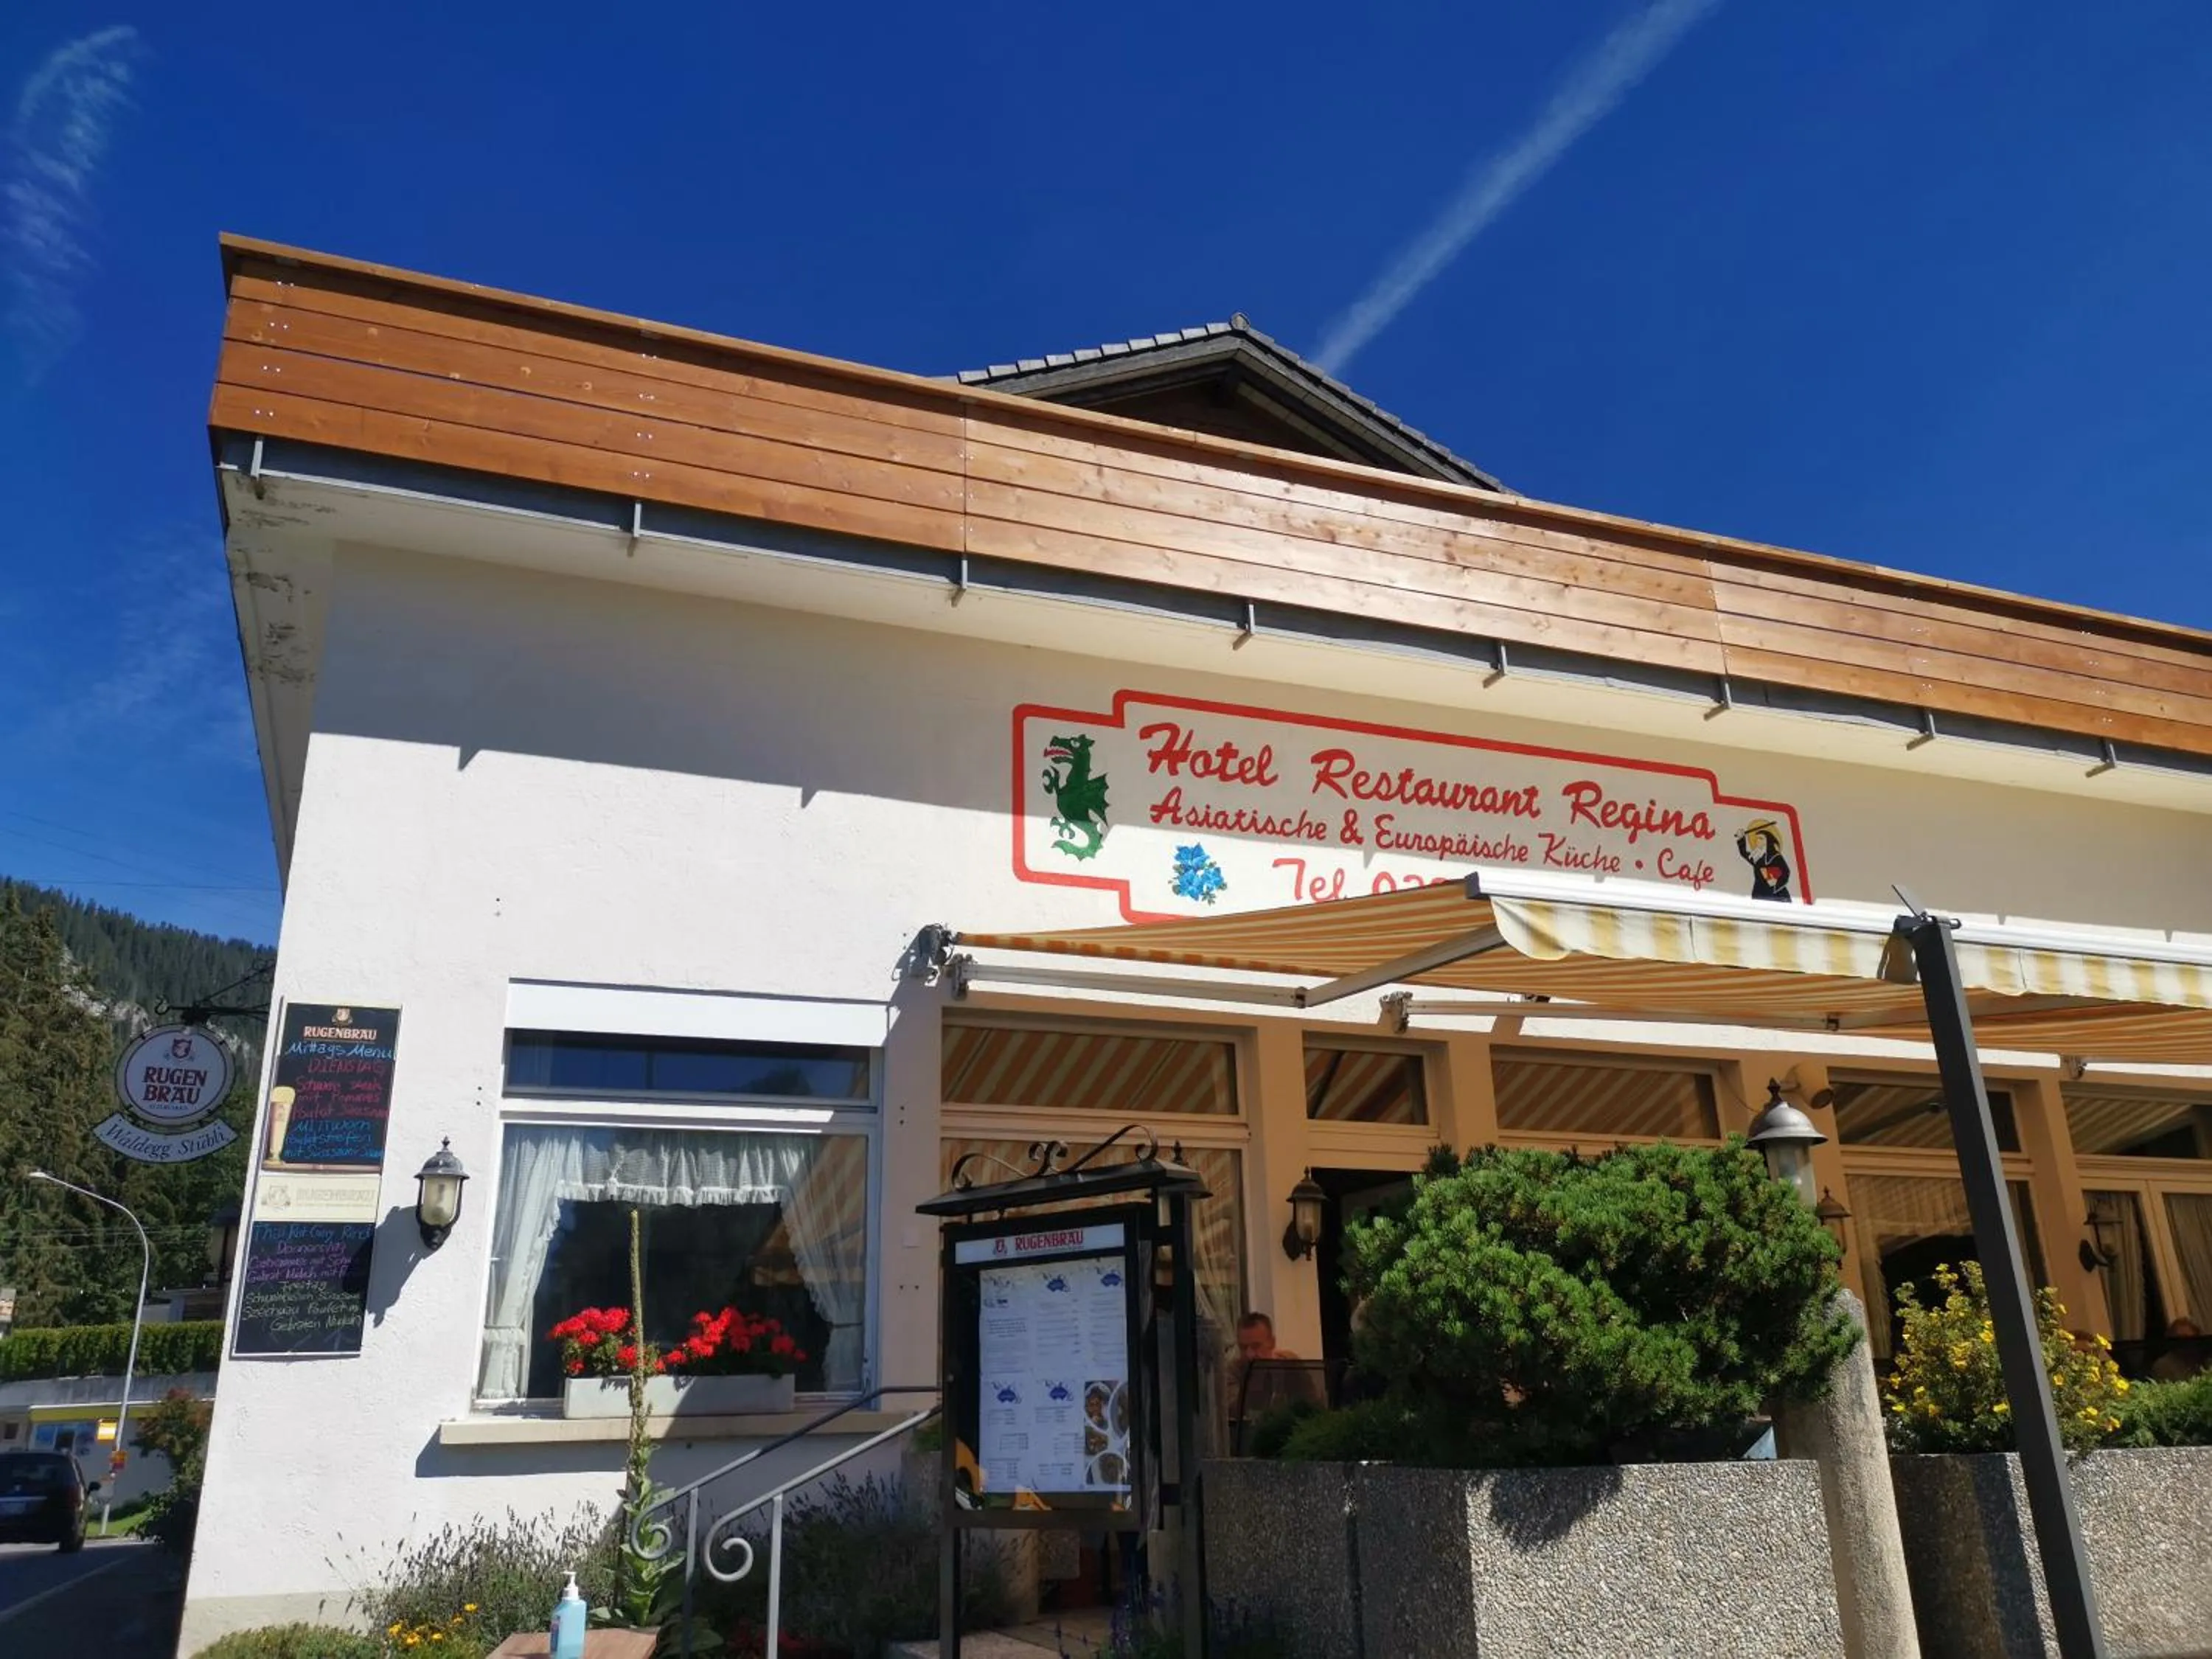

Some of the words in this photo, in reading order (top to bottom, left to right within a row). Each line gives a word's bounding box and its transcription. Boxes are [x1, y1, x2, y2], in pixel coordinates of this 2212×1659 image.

[1139, 723, 1279, 787] Hotel
[1310, 748, 1541, 818] Restaurant
[1562, 781, 1717, 844] Regina
[1150, 787, 1327, 841] Asiatische
[1340, 809, 1364, 845] &
[1375, 814, 1529, 863] Europäische
[1538, 832, 1621, 874] Küche
[1658, 848, 1714, 891] Cafe
[142, 1066, 207, 1087] RUGEN
[106, 1123, 173, 1161] Waldegg
